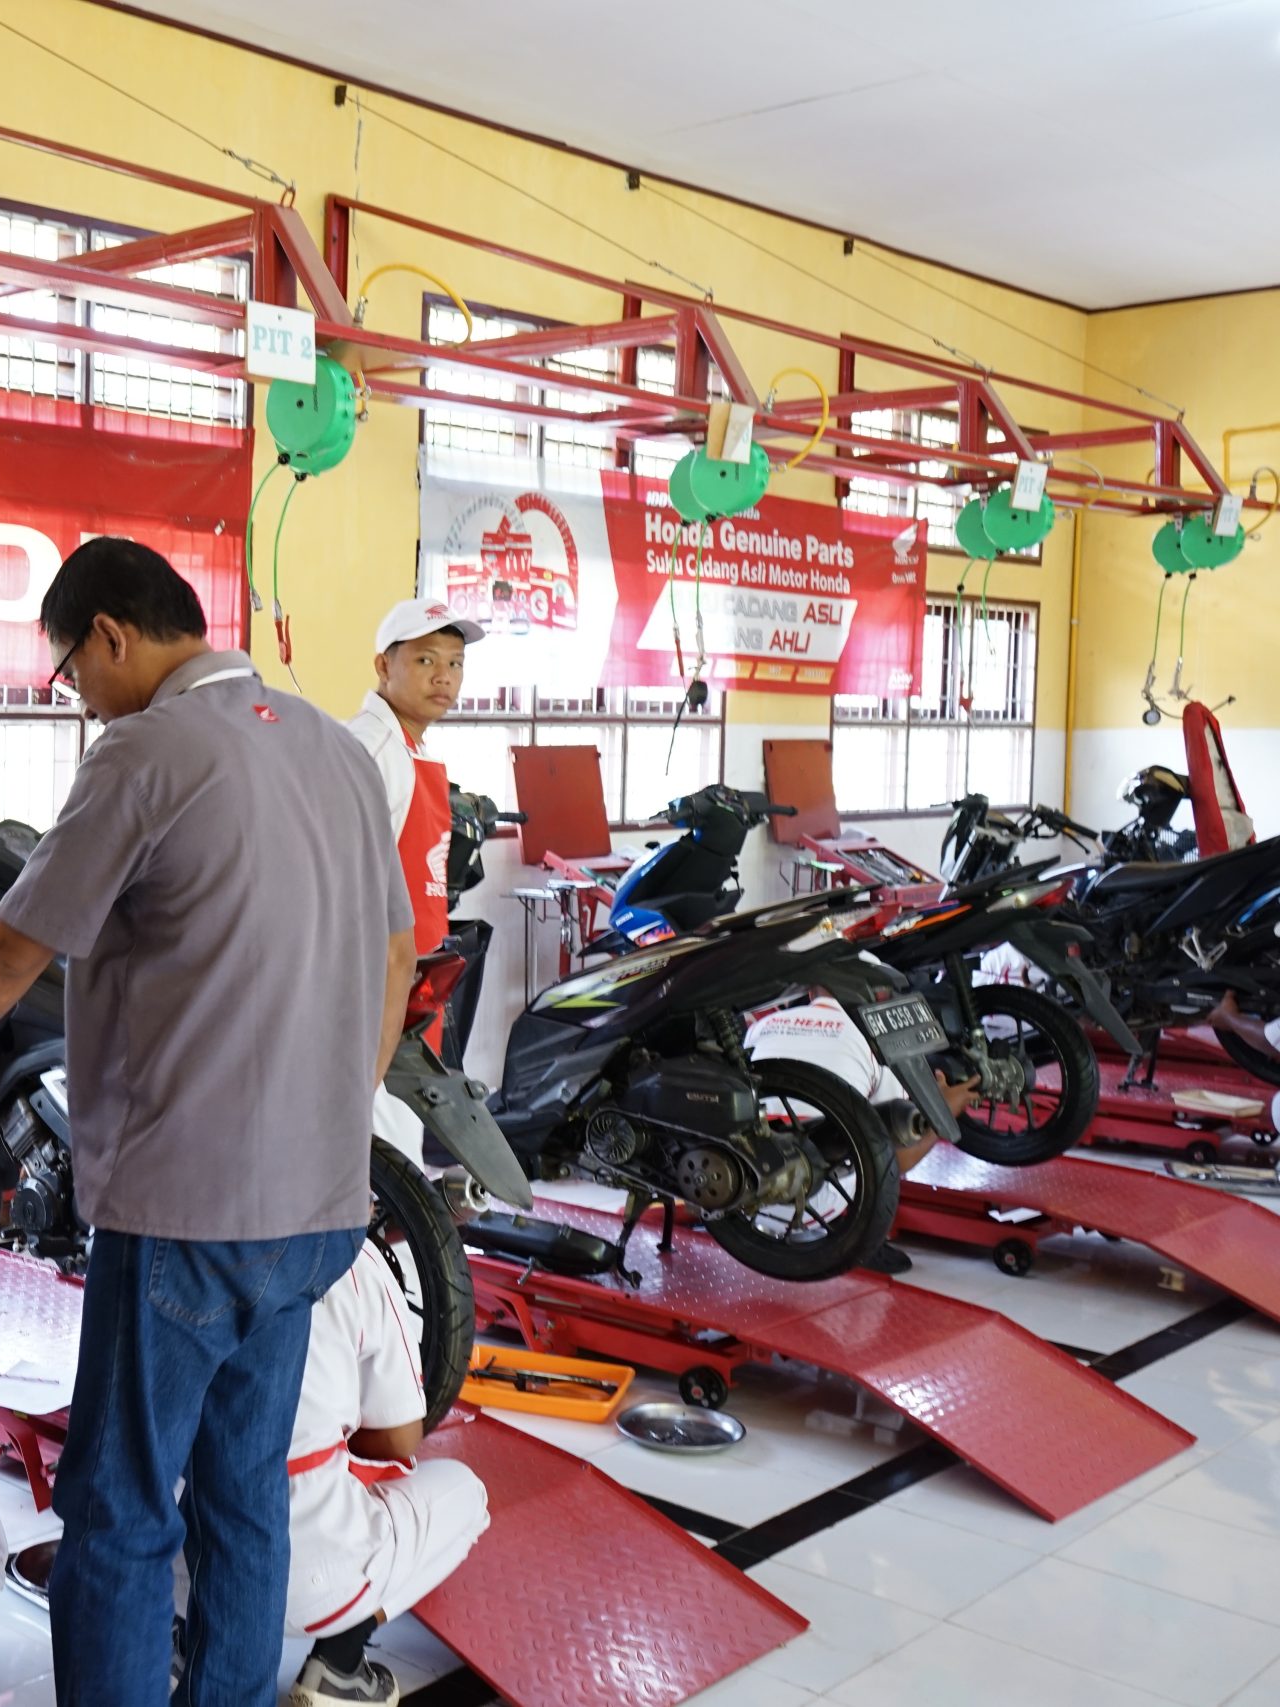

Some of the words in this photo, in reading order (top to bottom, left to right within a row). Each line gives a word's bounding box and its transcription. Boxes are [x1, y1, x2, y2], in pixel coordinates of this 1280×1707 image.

[252, 323, 293, 356] PIT
[300, 335, 313, 360] 2
[645, 511, 714, 549] Honda
[719, 520, 803, 561] Genuine
[806, 534, 855, 569] Parts
[646, 548, 683, 576] Suku
[685, 552, 739, 583] Cadang
[741, 559, 767, 583] Asli
[769, 565, 808, 590] Motor
[810, 571, 851, 595] Honda
[803, 601, 843, 626] ASLI
[769, 629, 811, 654] AHLI
[794, 1017, 845, 1029] HEART
[886, 1005, 915, 1031] 6358
